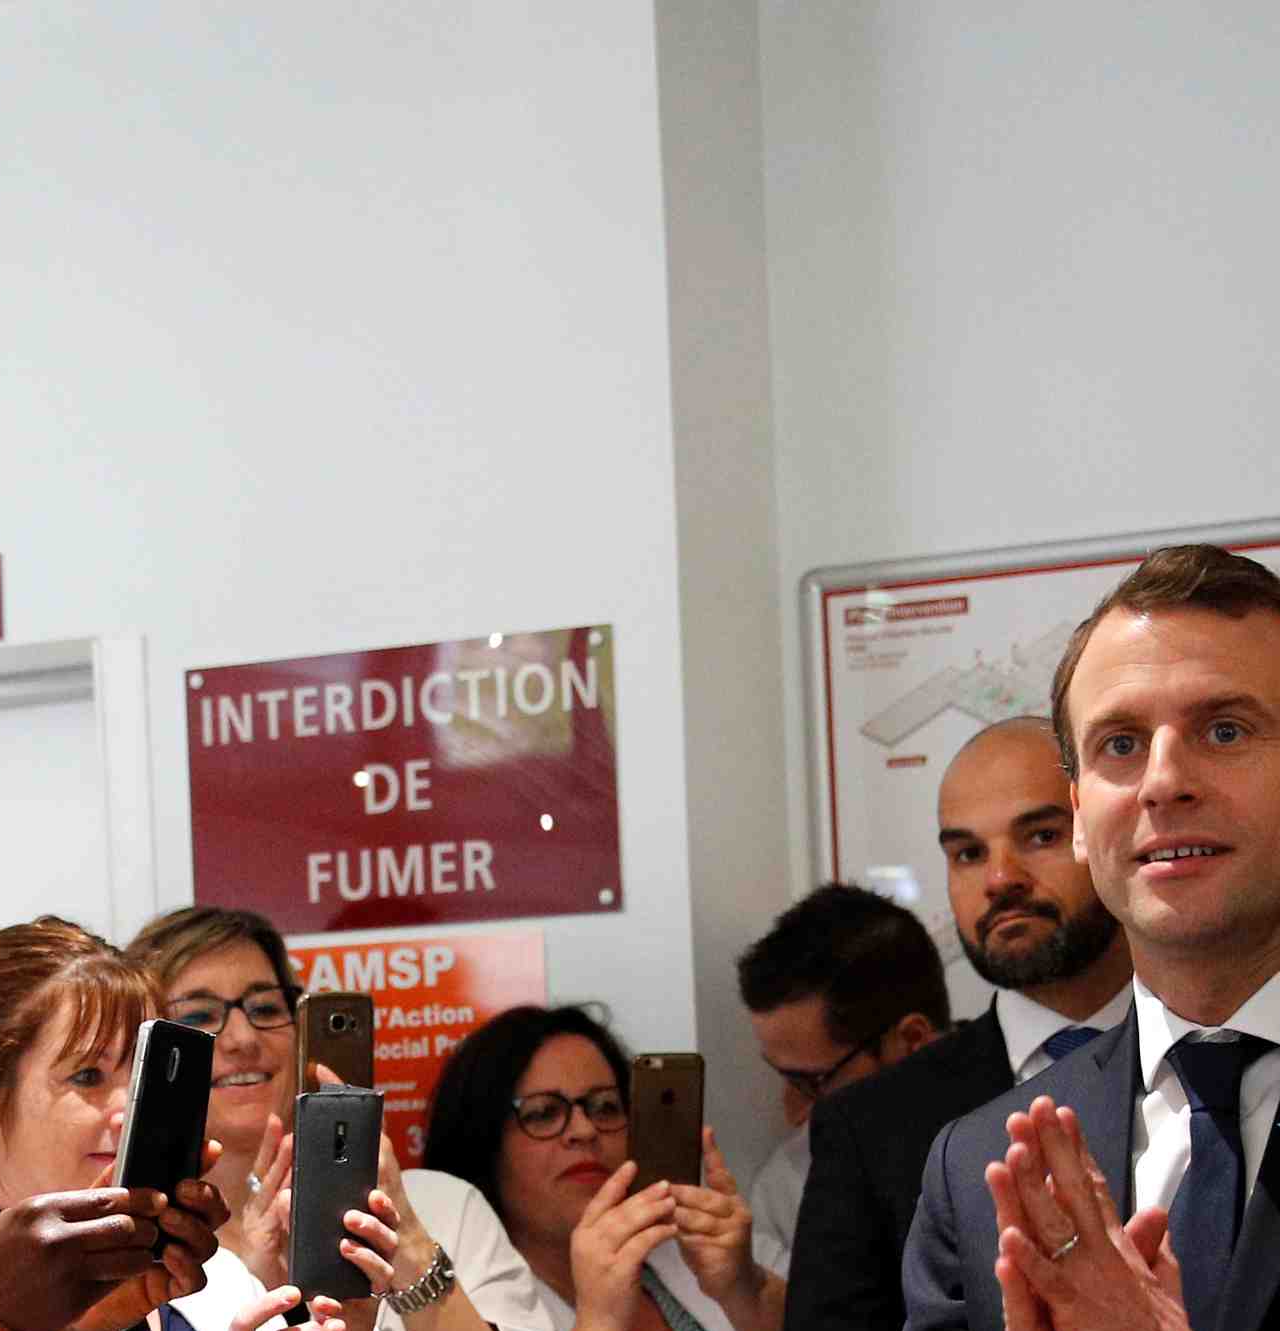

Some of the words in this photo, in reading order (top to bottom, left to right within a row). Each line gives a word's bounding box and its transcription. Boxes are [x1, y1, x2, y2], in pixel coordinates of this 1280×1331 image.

[201, 658, 598, 747] INTERDICTION
[363, 760, 432, 815] DE
[307, 841, 496, 904] FUMER
[374, 1036, 429, 1060] ocial
